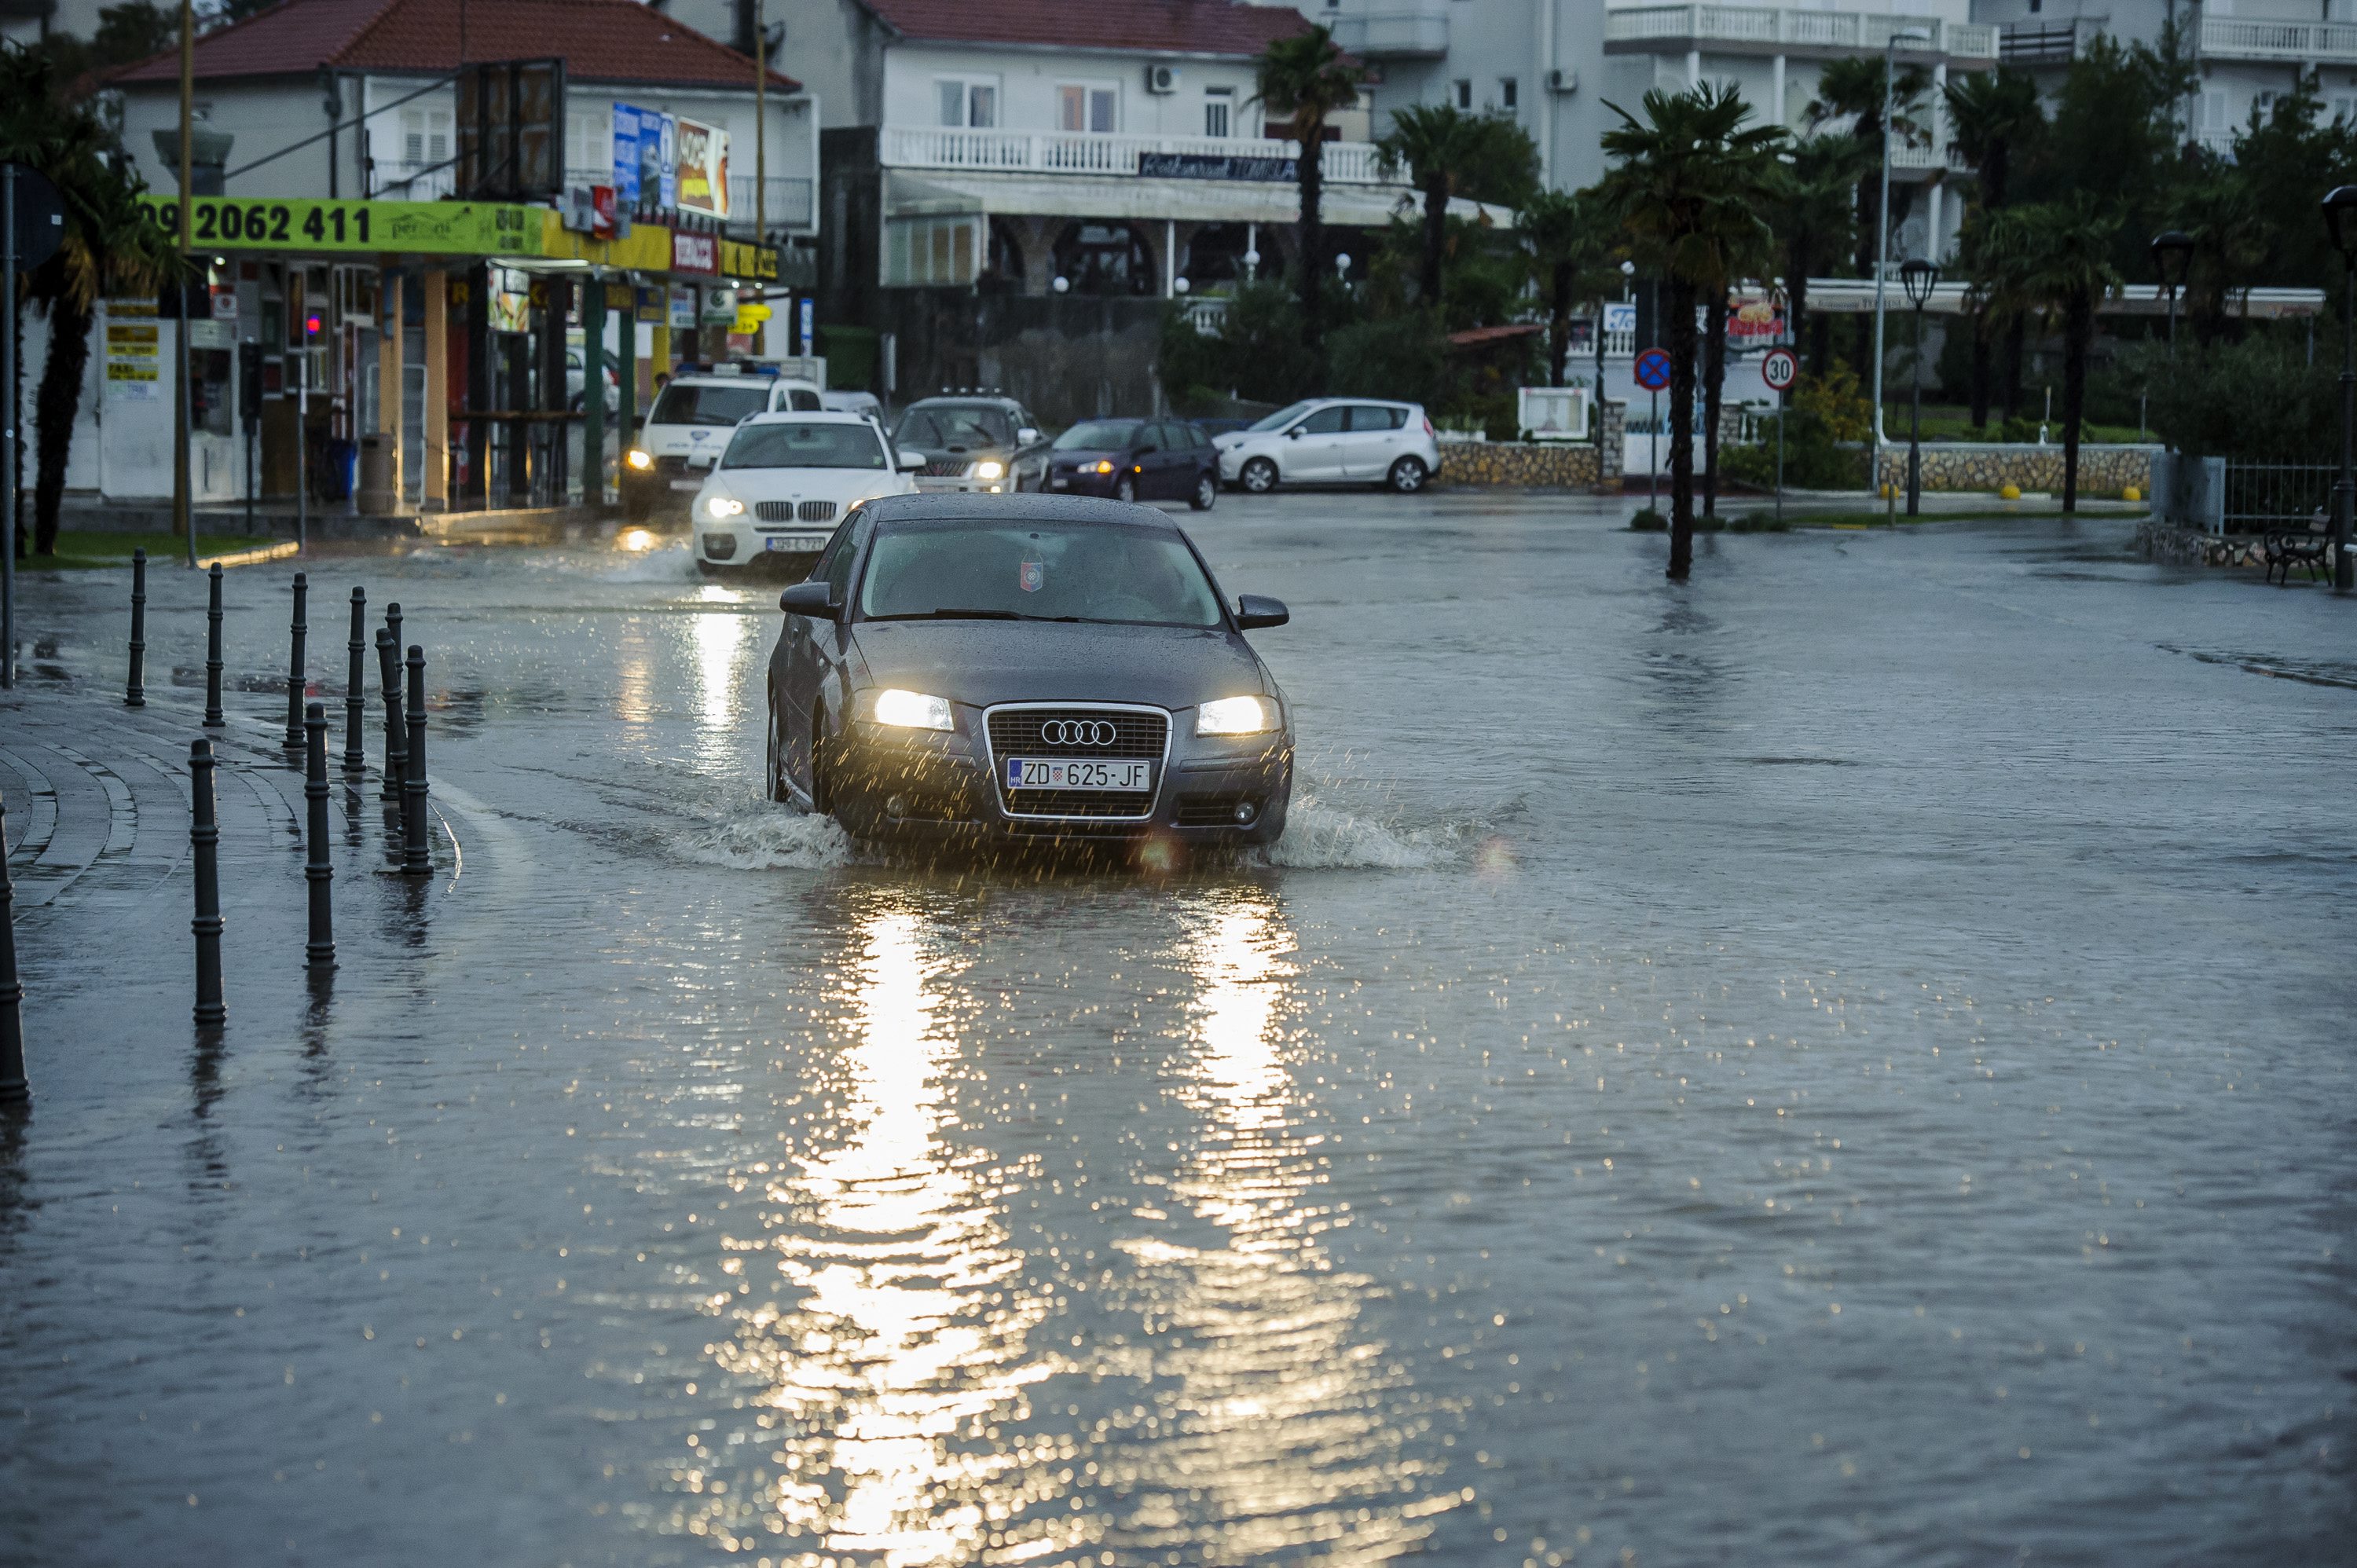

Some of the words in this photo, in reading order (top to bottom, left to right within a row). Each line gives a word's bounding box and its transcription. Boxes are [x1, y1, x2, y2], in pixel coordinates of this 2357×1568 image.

[196, 203, 290, 241] 2062
[302, 206, 370, 244] 411
[1769, 359, 1791, 380] 30
[1024, 763, 1050, 785] ZD
[1068, 764, 1144, 786] 625-JF
